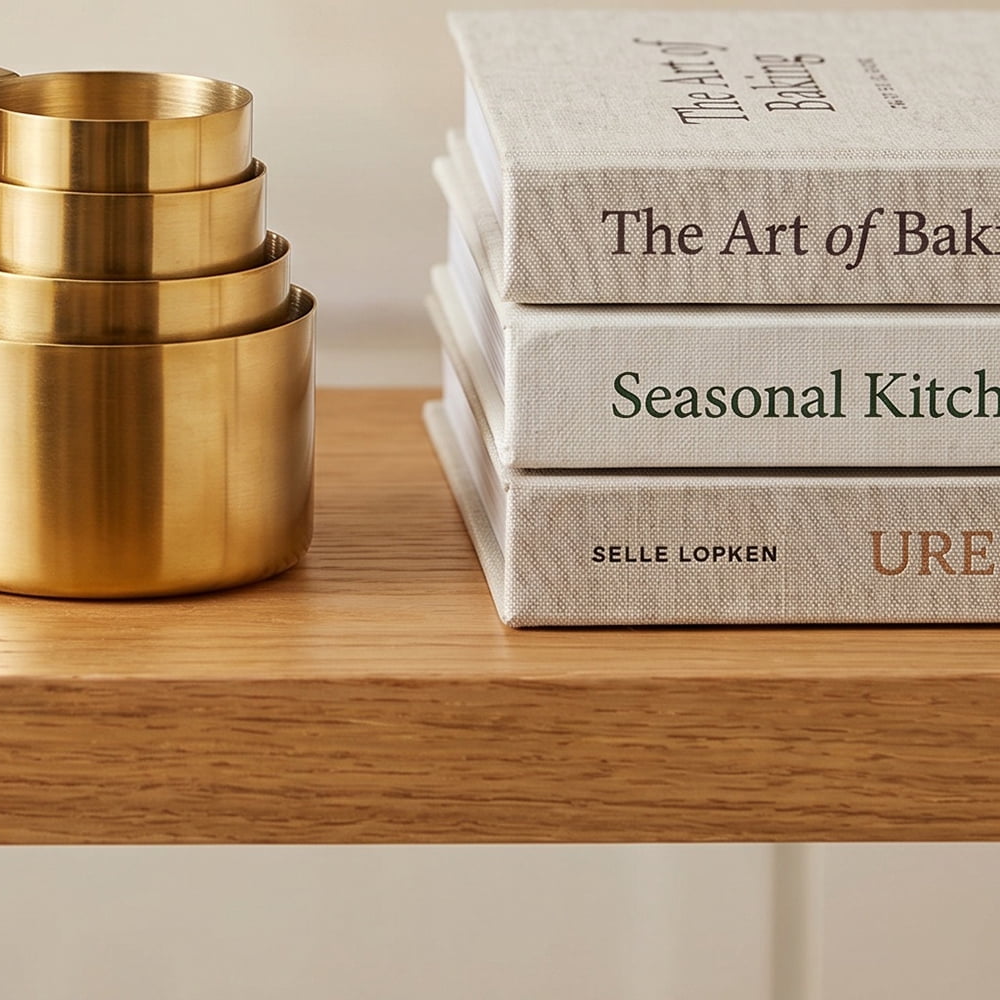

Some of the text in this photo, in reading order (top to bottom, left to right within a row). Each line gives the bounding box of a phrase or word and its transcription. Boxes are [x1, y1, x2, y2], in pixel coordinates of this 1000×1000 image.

[632, 36, 751, 125] The Art of
[744, 53, 836, 112] Baking
[601, 207, 1000, 271] The Art of Bak
[611, 368, 1000, 419] Seasonal Kitch
[591, 545, 778, 563] SELLE LOPKEN
[871, 530, 995, 576] URE
